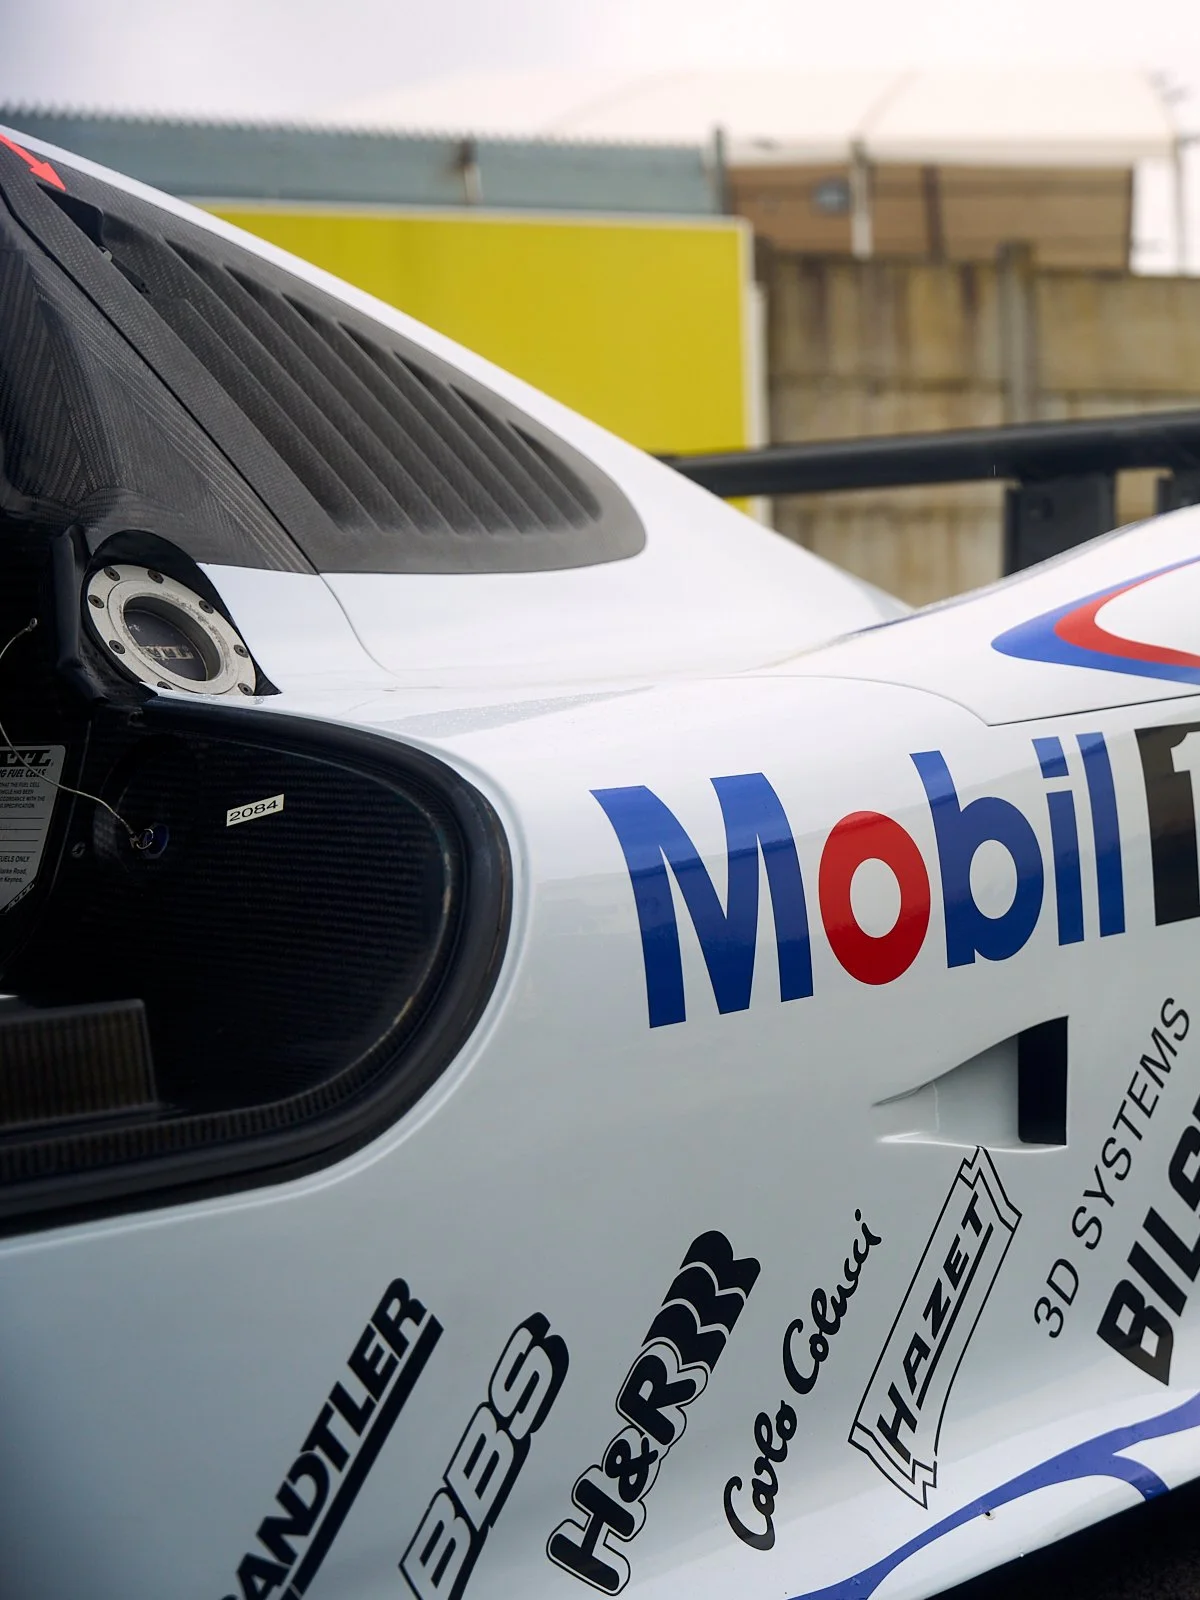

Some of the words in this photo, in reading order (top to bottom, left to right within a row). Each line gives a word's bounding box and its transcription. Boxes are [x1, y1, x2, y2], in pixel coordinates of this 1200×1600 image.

[229, 800, 278, 822] 2084
[589, 732, 1126, 1029] Mobil
[1033, 1258, 1080, 1339] 3D
[1071, 997, 1191, 1251] SYSTEMS
[220, 1277, 428, 1600] ANDTLER
[398, 1311, 570, 1600] BBS
[723, 1400, 798, 1551] Carlo
[782, 1208, 882, 1395] Colucci
[875, 1190, 988, 1461] HAZET
